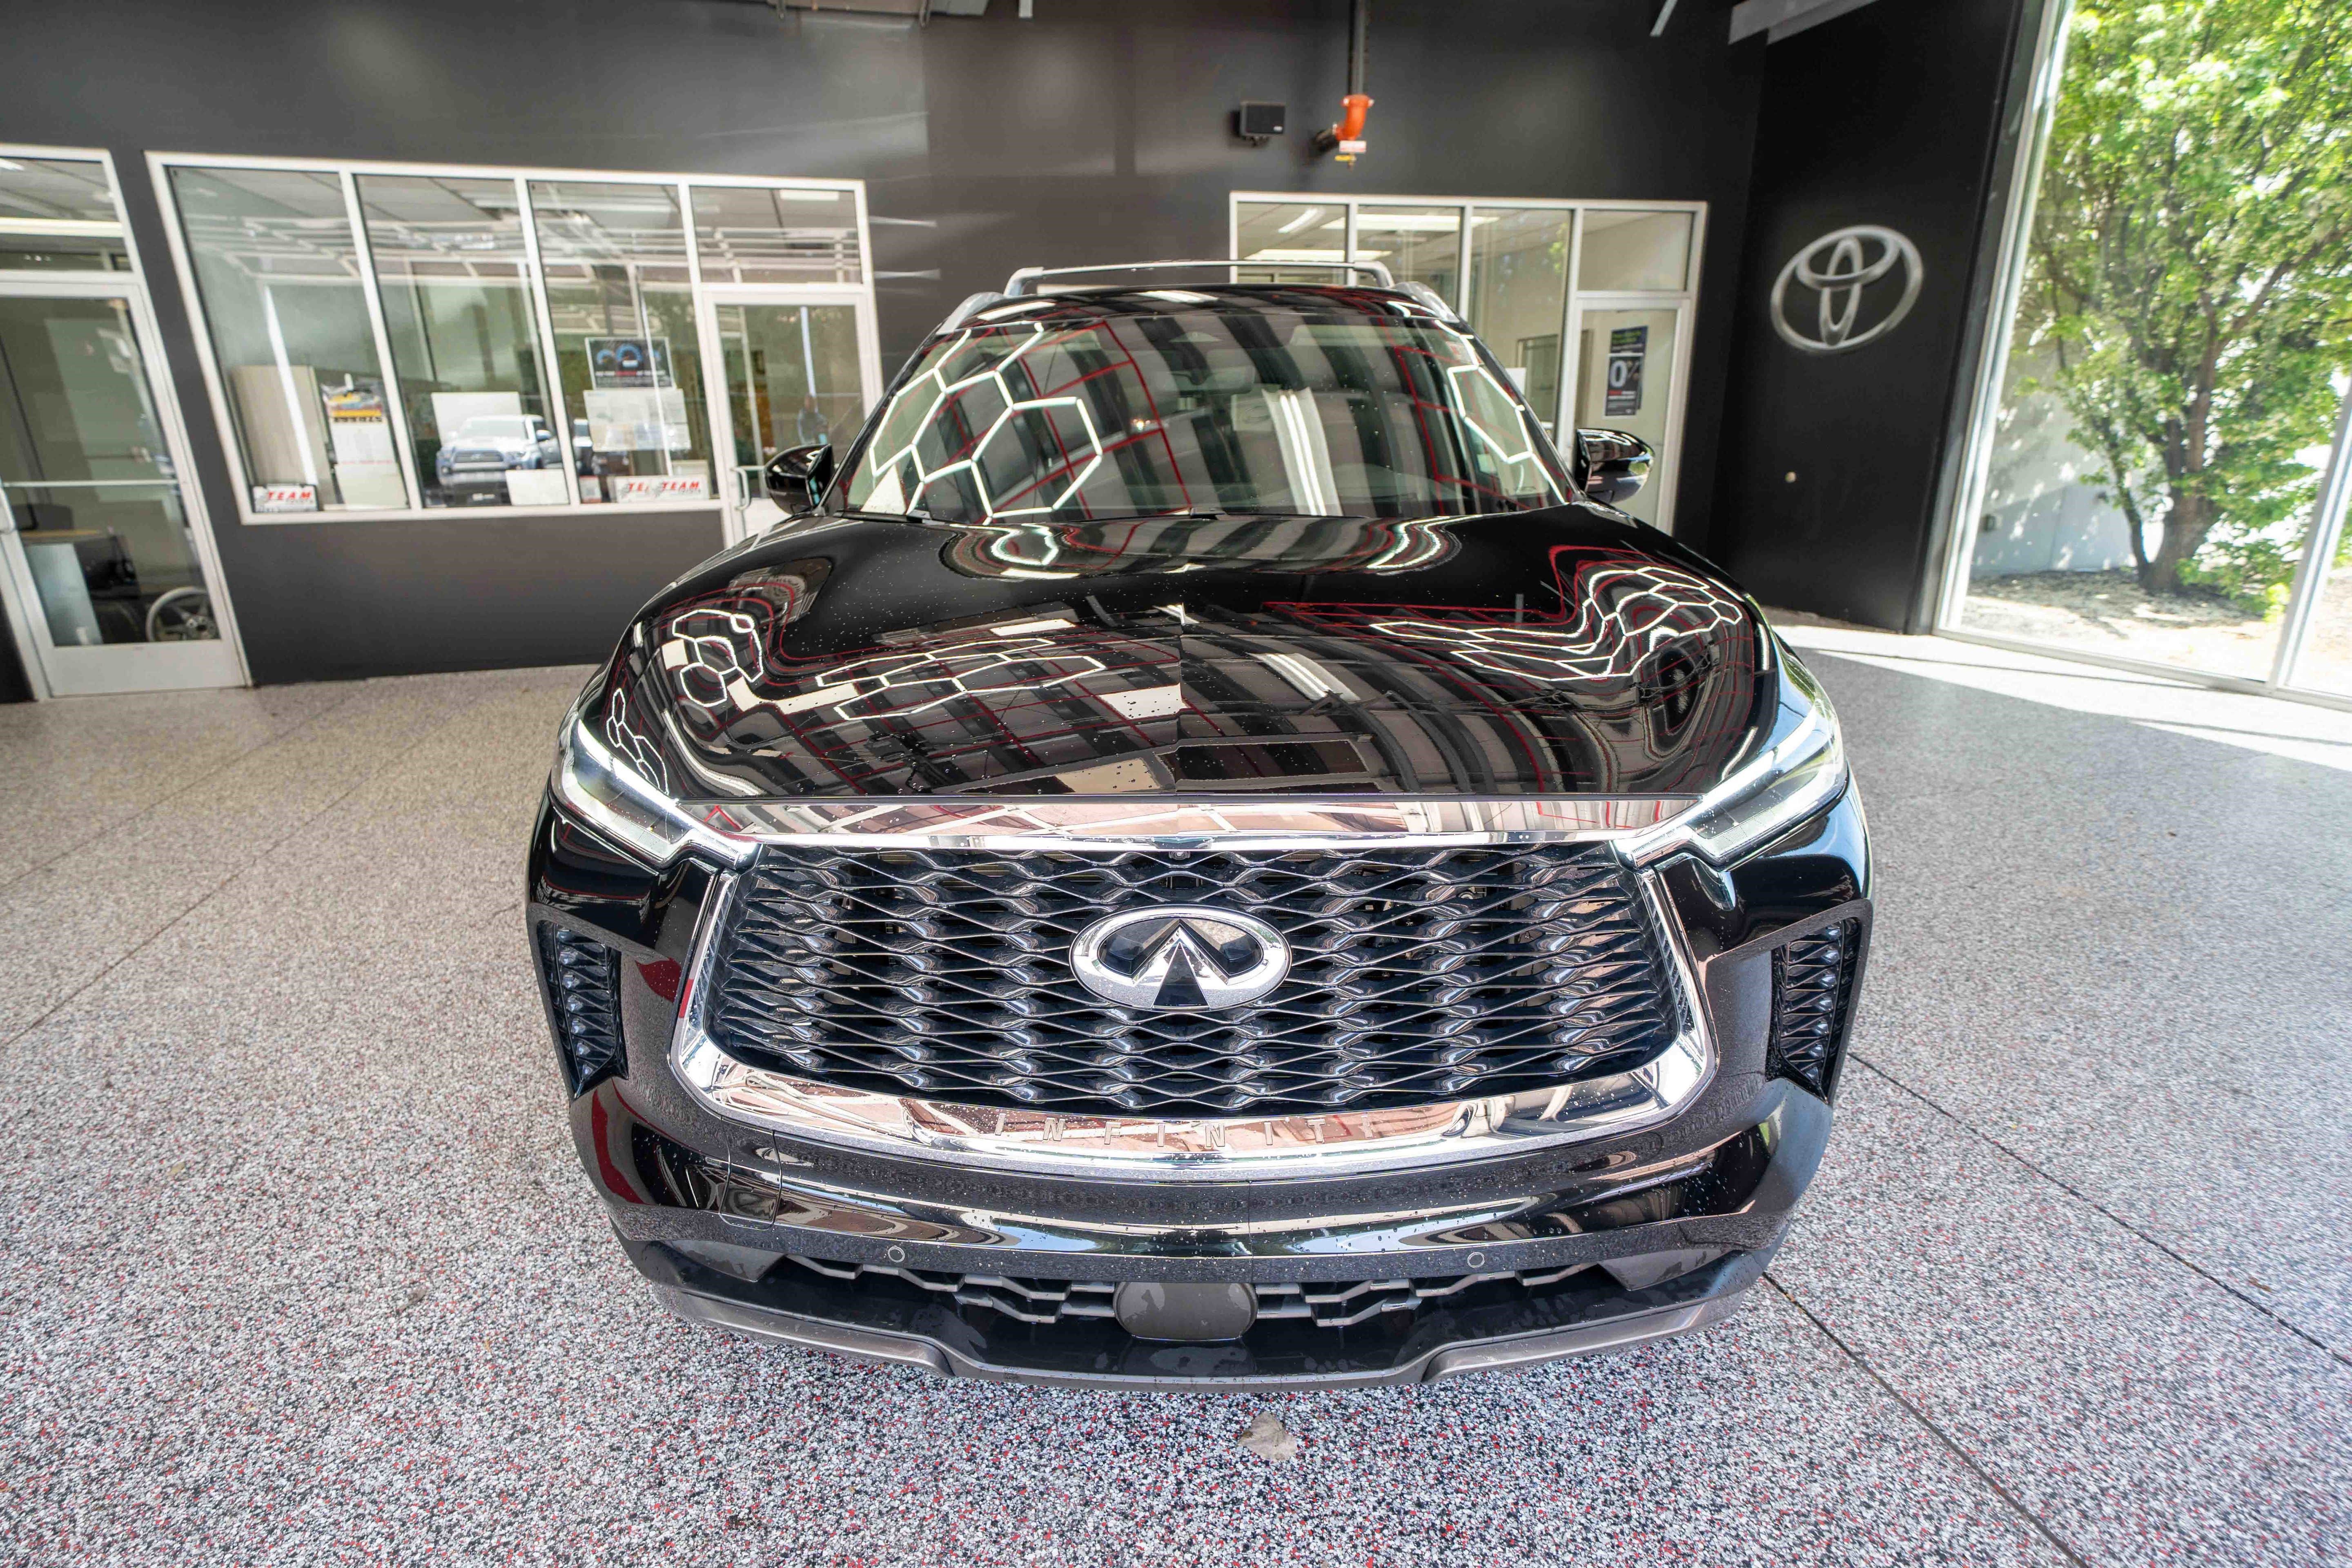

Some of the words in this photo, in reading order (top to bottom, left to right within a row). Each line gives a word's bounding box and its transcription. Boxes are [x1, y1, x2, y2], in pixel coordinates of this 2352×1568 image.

[660, 481, 699, 491] TEAM
[267, 491, 312, 501] TEAM
[995, 1113, 1373, 1148] INFINITI
